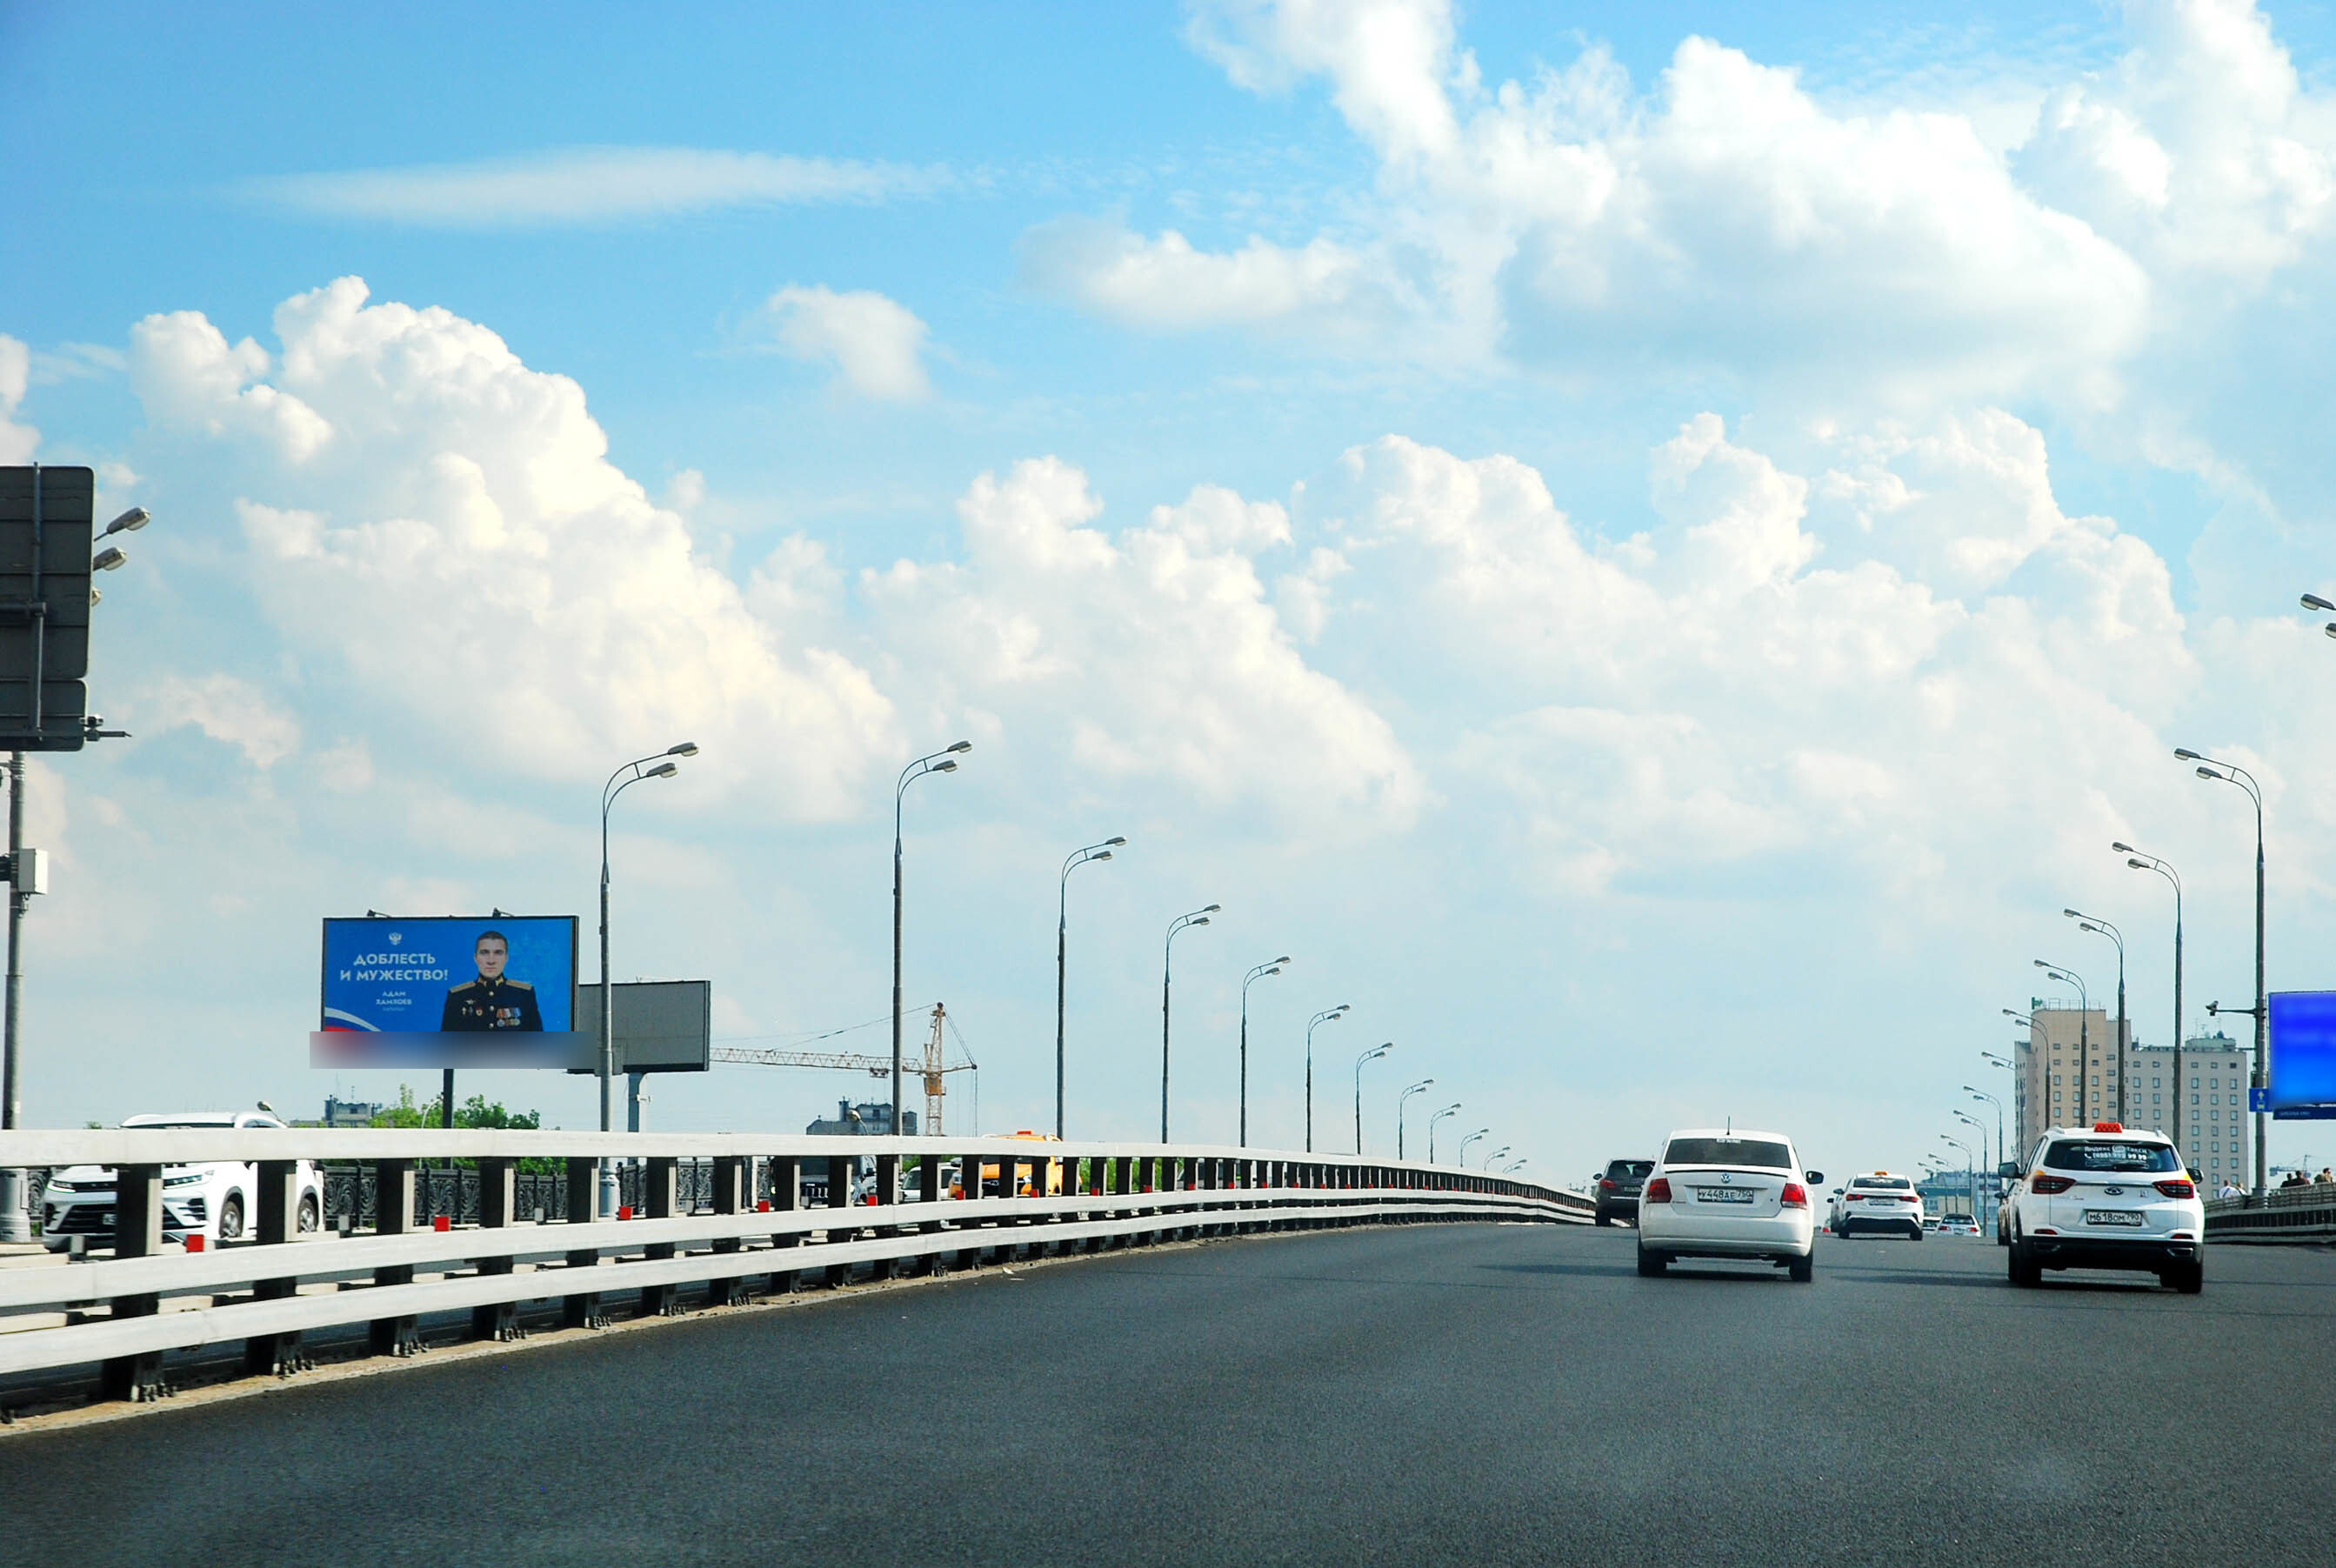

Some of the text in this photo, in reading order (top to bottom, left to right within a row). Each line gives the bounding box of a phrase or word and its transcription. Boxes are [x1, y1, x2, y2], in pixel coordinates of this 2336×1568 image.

[352, 953, 436, 966] ДОБЛЕСТЬ
[340, 969, 449, 981] И МУЖЕСТВО!
